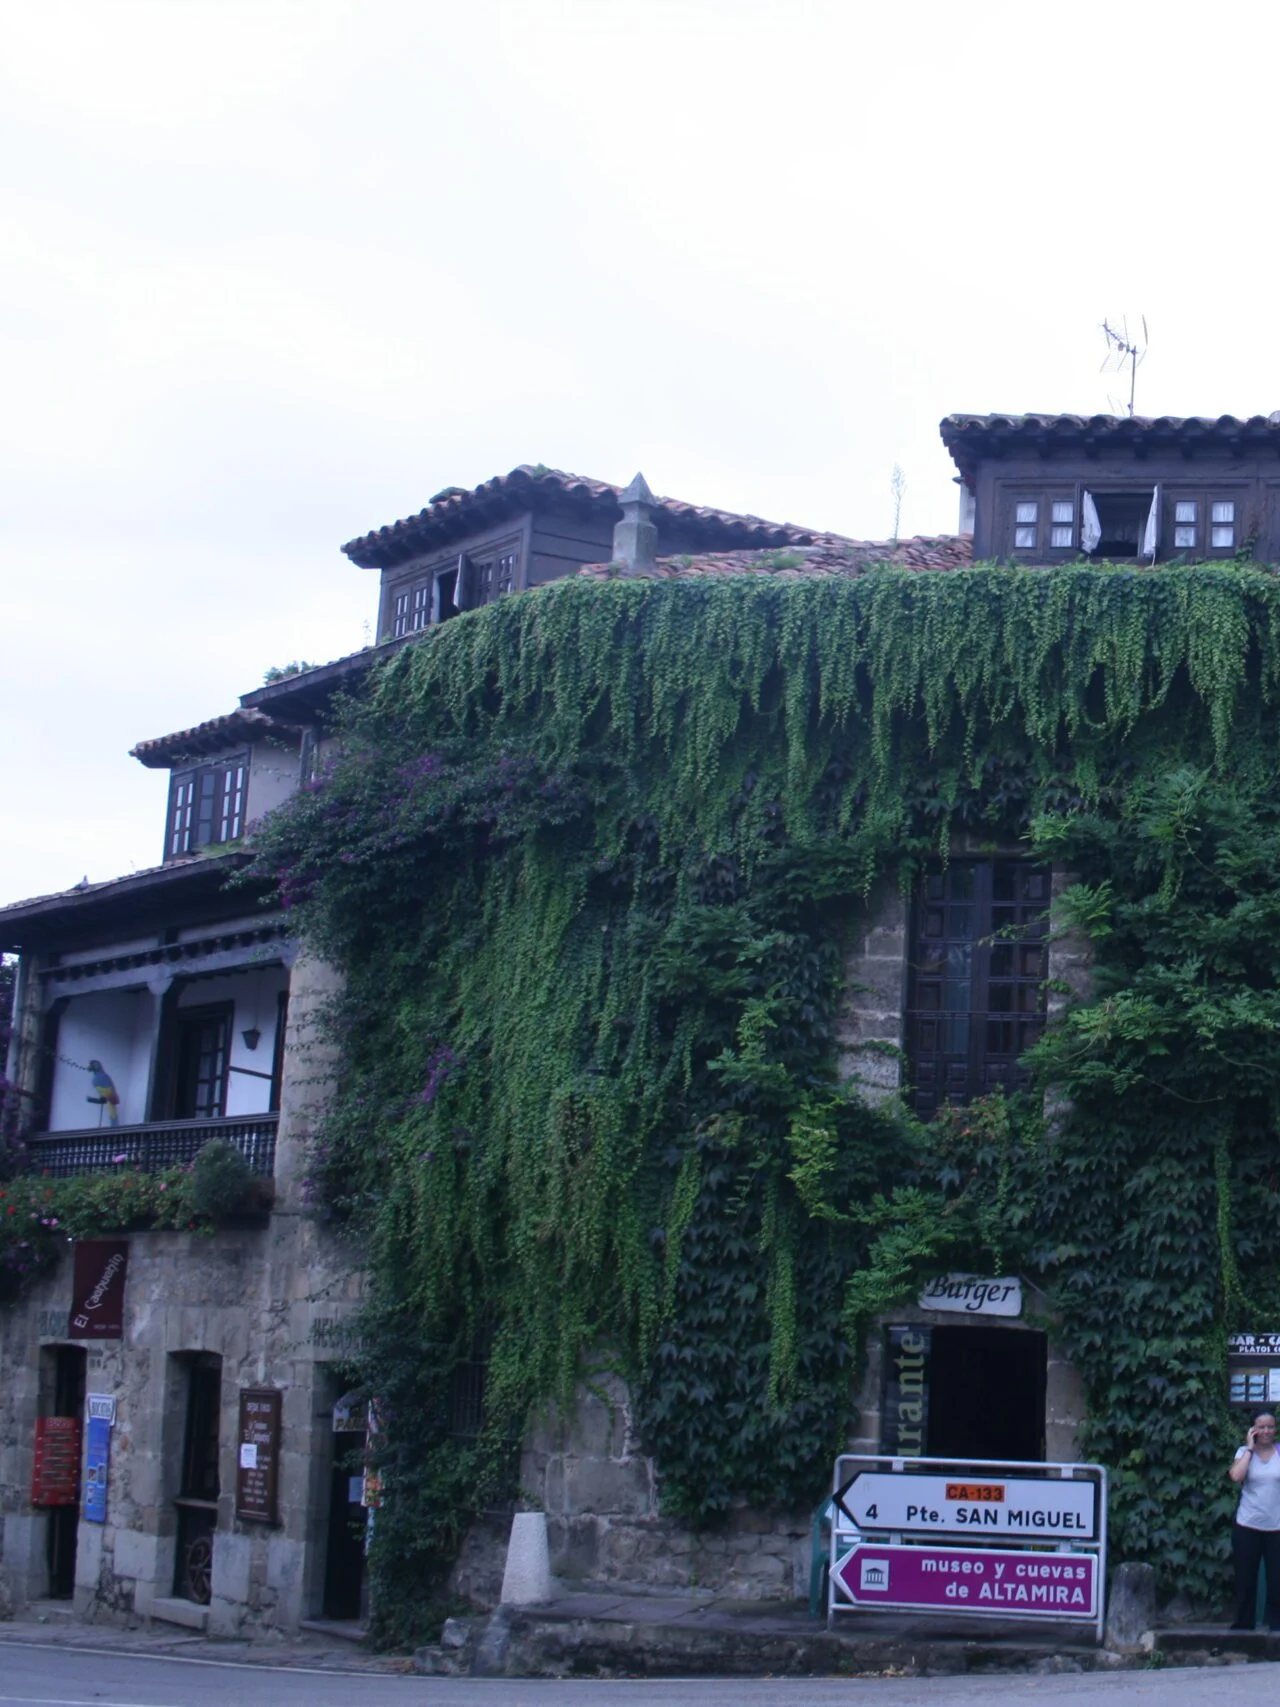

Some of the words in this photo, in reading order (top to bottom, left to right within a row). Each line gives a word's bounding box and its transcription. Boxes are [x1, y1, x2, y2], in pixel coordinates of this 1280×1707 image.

[925, 1274, 1015, 1311] Burger
[74, 1313, 89, 1329] El
[946, 1485, 1004, 1502] CA-133
[865, 1503, 879, 1520] 4
[906, 1505, 945, 1524] Pte.
[955, 1508, 999, 1526] SAN
[1007, 1509, 1086, 1530] MIGUEL
[921, 1558, 984, 1575] museo
[994, 1562, 1005, 1579] y
[1015, 1561, 1086, 1580] cuevas
[945, 1581, 969, 1599] de
[978, 1582, 1085, 1605] ALTAMIRA
